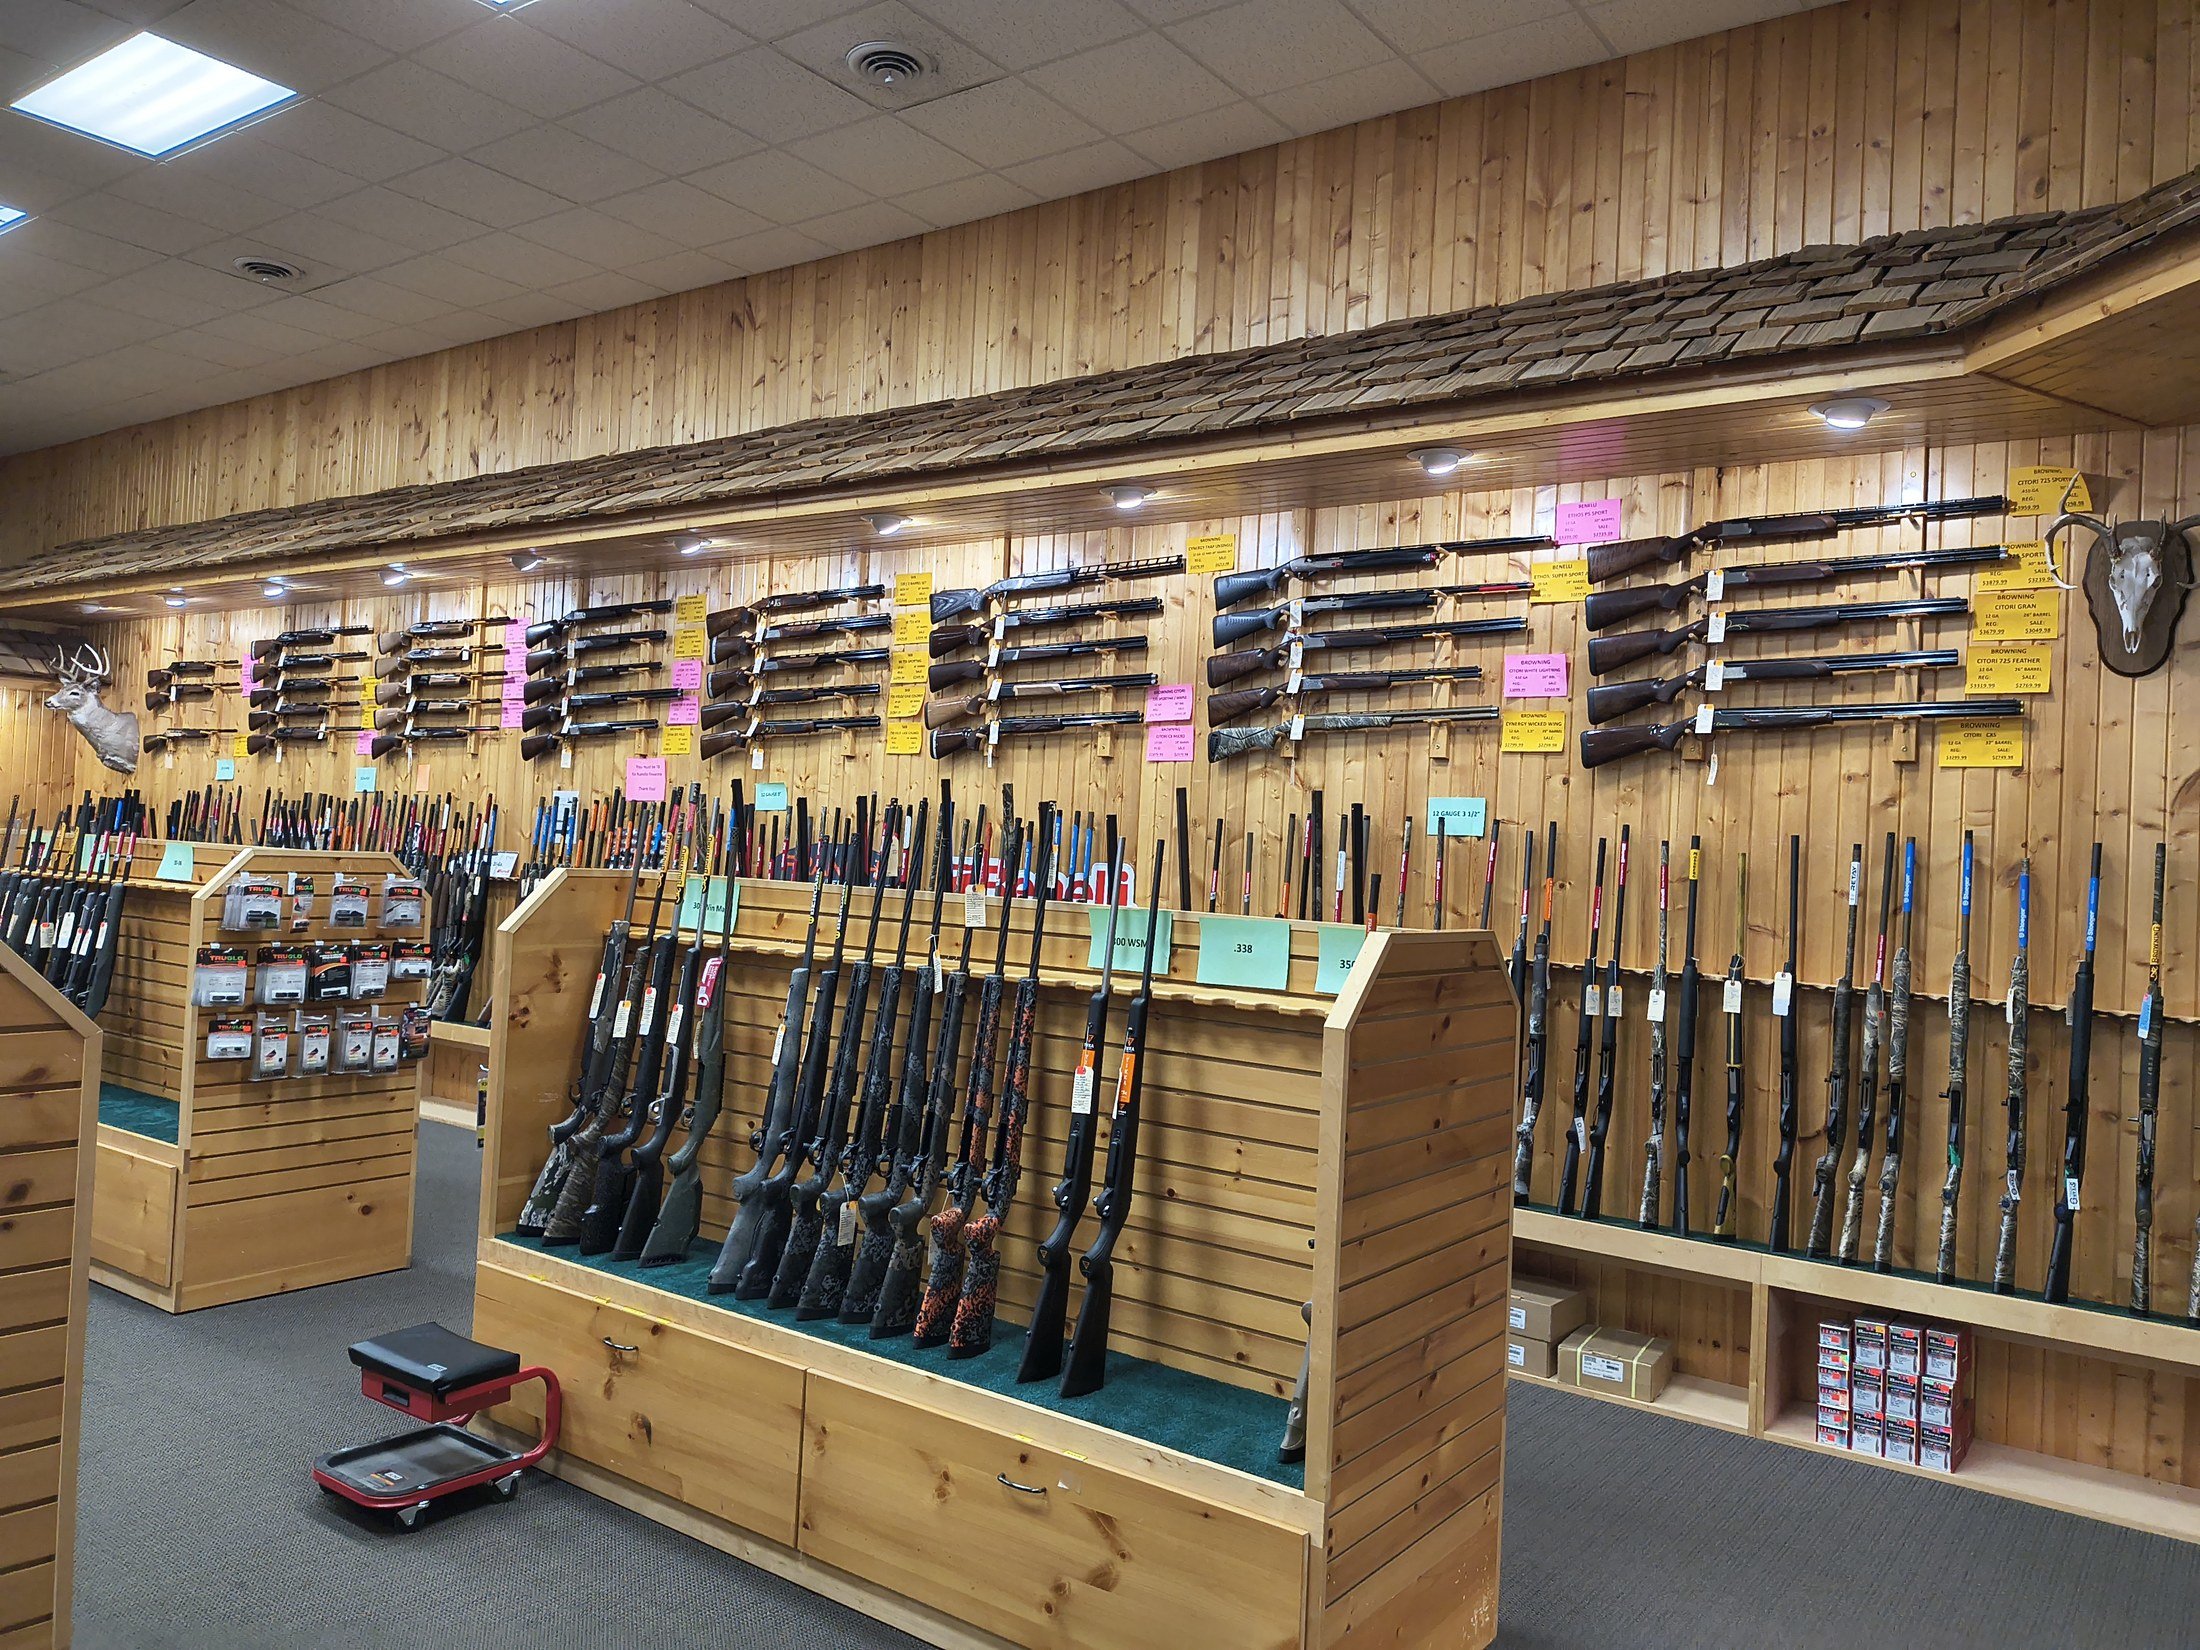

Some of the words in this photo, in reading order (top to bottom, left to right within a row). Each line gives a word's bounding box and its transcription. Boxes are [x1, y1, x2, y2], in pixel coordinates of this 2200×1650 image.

[1904, 873, 1912, 897] Stoeger
[1234, 944, 1252, 954] .338
[2151, 926, 2160, 963] BROWNING
[1892, 1335, 1916, 1344] Hornady
[1856, 1415, 1880, 1425] Hornady
[1888, 1422, 1912, 1432] Hornady
[1924, 1430, 1949, 1440] Hornady
